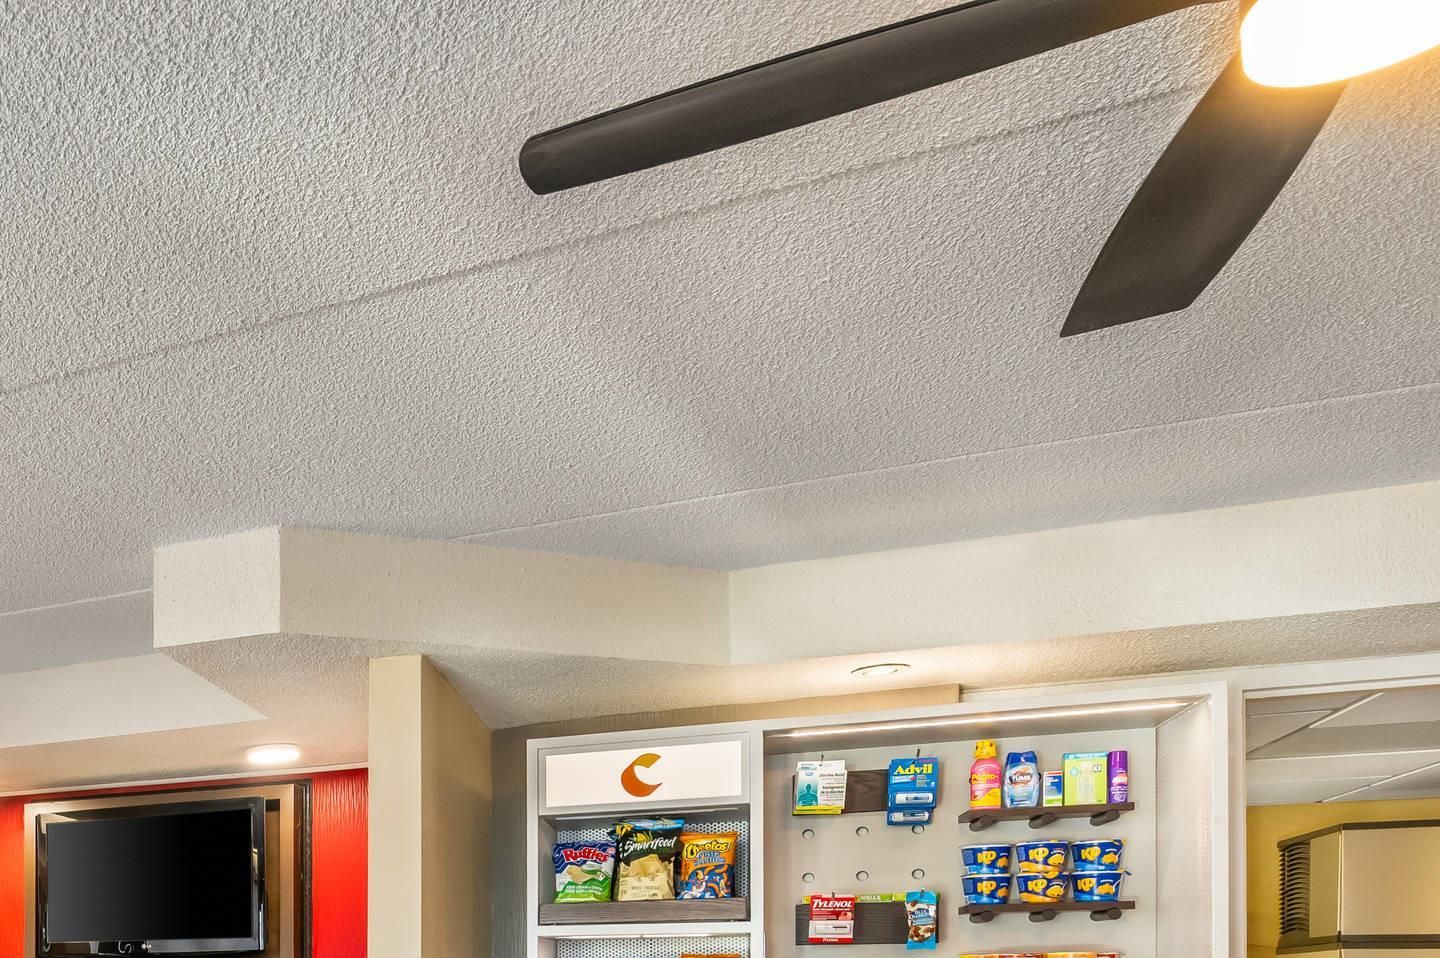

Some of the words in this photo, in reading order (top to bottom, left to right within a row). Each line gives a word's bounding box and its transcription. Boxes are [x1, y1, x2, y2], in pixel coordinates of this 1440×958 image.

[894, 763, 933, 775] Advil
[624, 836, 677, 856] Smartfood
[686, 840, 729, 859] Cheetos
[561, 847, 609, 863] Ruffles
[812, 898, 852, 908] TYLENOL
